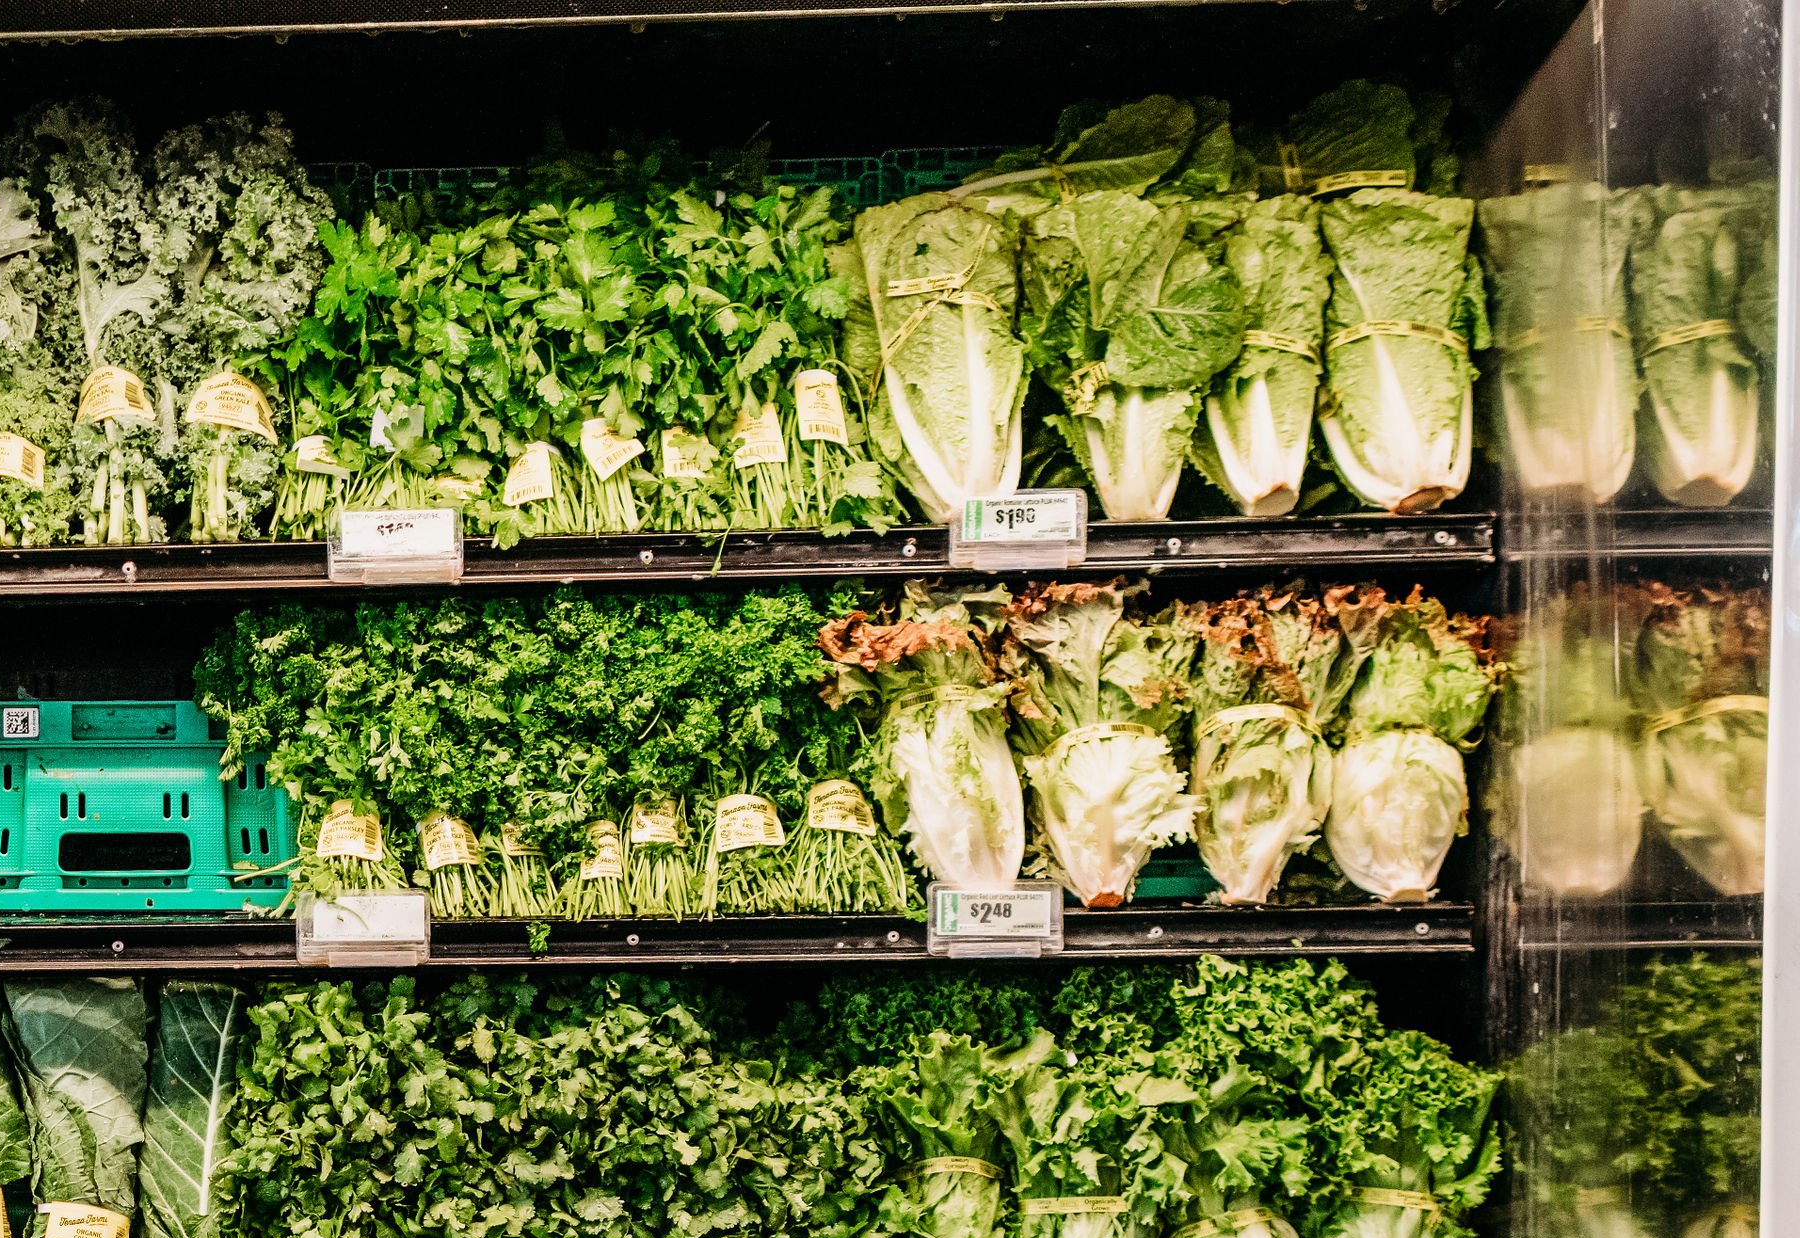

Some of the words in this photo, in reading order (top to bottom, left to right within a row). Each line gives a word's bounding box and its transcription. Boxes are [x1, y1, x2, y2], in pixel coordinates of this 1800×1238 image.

[220, 389, 246, 398] ORGANIC
[214, 395, 233, 403] GREEN
[233, 397, 250, 406] KALE
[821, 799, 847, 808] ORGANIC
[340, 825, 365, 834] PARSLEY
[970, 902, 1013, 924] $248
[84, 1213, 109, 1227] Farms
[75, 1227, 104, 1238] ORGANIC
